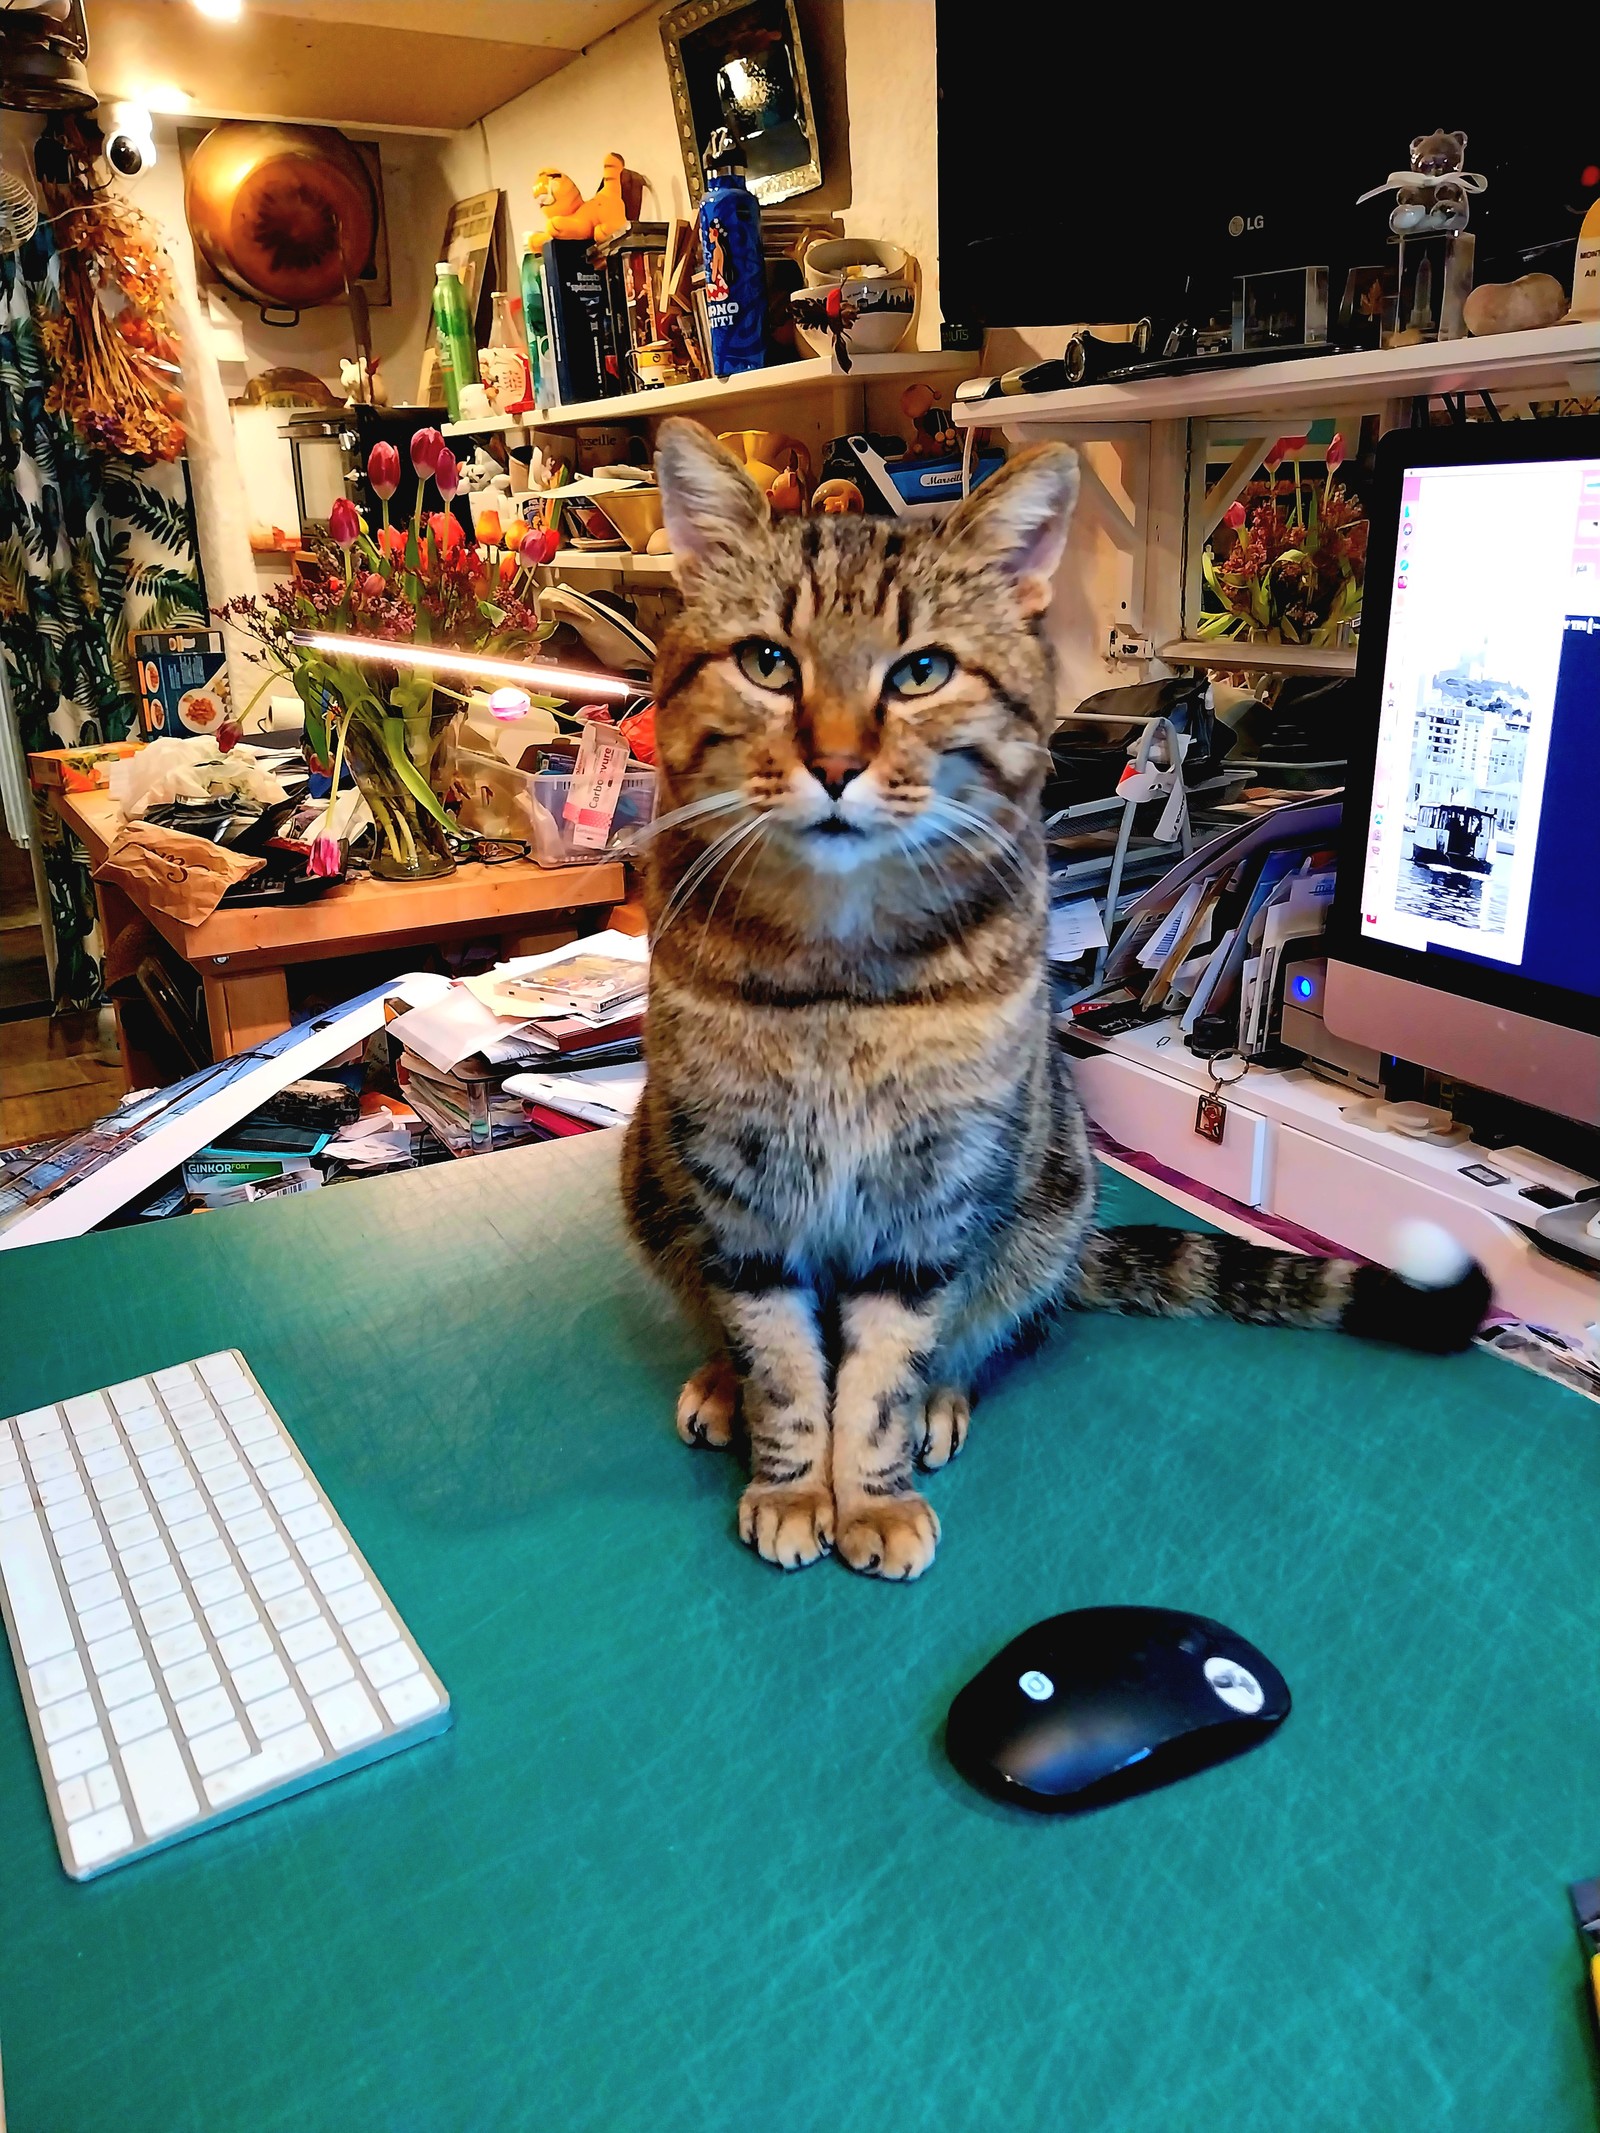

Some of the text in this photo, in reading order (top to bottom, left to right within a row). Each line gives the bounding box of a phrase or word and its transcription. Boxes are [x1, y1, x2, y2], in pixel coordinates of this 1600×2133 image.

[1246, 215, 1264, 230] LG
[708, 302, 739, 317] ANO
[711, 315, 734, 328] ITI
[927, 473, 963, 485] Marseill
[589, 747, 612, 809] Carbovure
[188, 1163, 232, 1173] GINKOR
